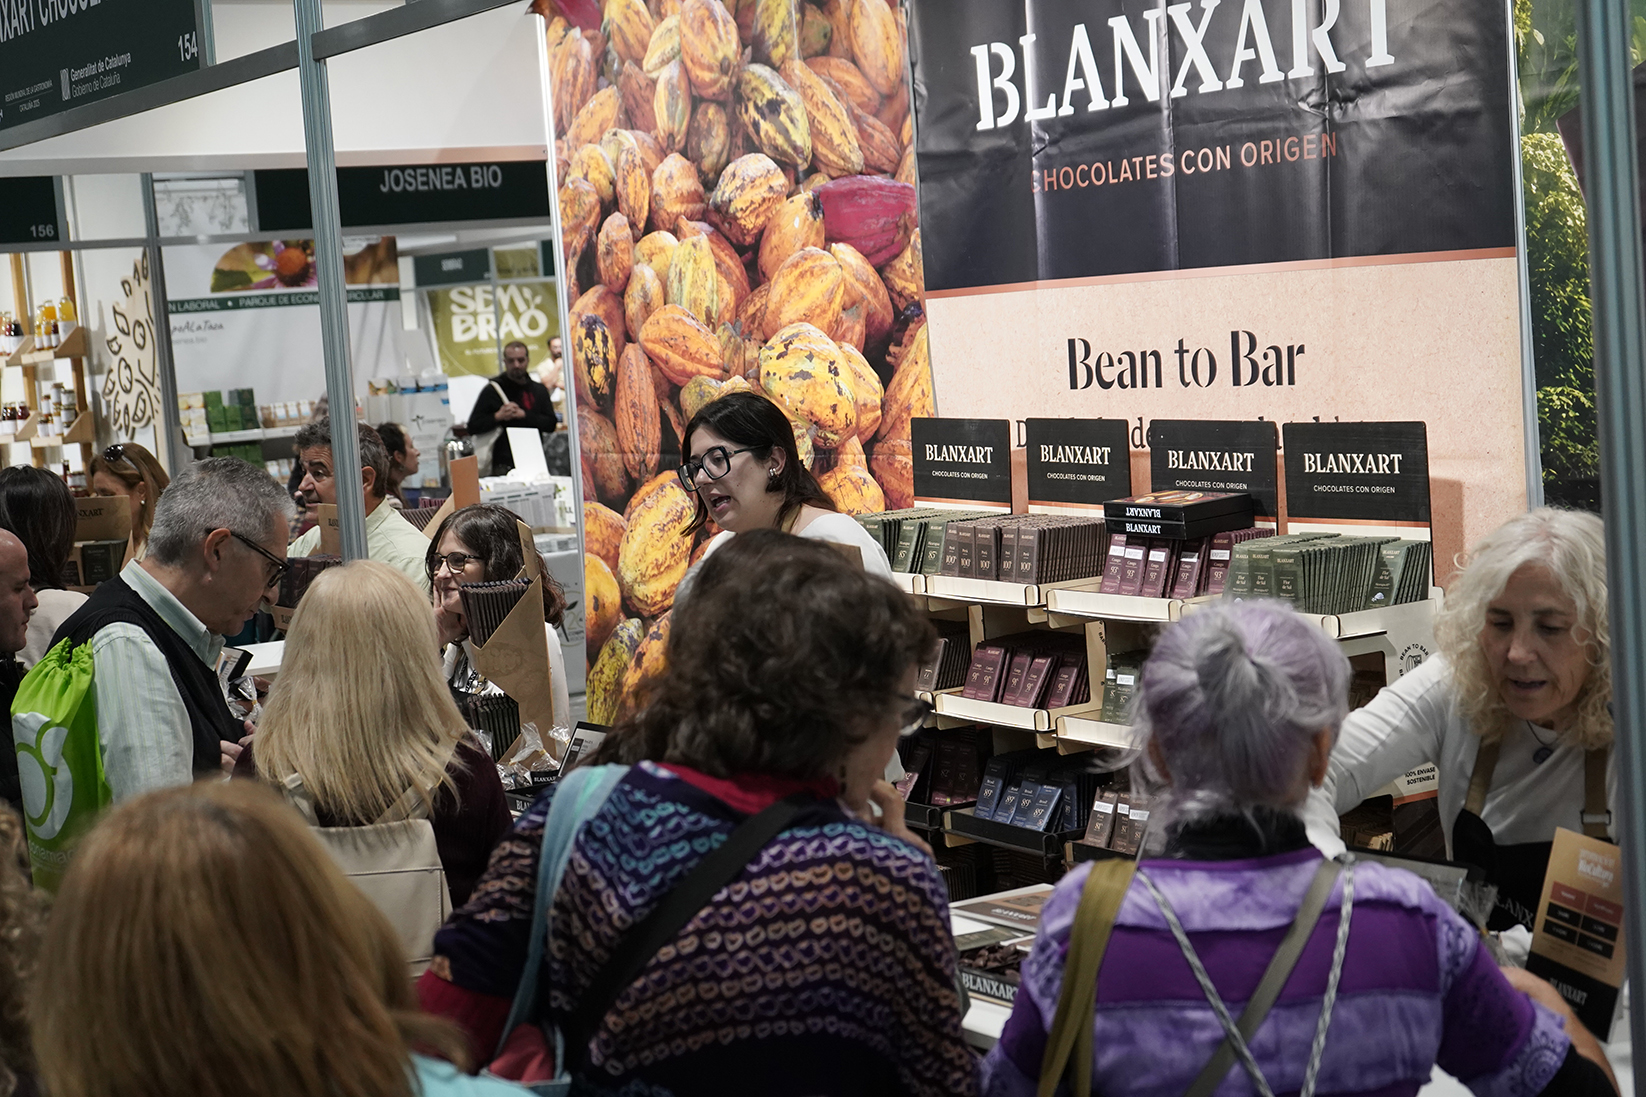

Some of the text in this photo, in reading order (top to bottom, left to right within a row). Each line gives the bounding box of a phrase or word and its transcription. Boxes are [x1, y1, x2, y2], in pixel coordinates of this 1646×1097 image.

[178, 31, 199, 61] 154
[70, 52, 132, 82] Generalitat de Catalunya
[970, 0, 1395, 131] BLANXART
[71, 83, 93, 98] Gobierno
[1030, 131, 1338, 194] CHOCOLATES CON ORIGEN
[380, 165, 502, 193] JOSENEA BIO
[30, 224, 54, 238] 156
[176, 299, 220, 312] LABORAL
[239, 295, 278, 307] PARQUE
[278, 294, 290, 305] DE
[1067, 329, 1305, 390] Bean to Bar
[925, 444, 993, 464] BLANXART
[1040, 445, 1111, 465] BLANXART
[1167, 450, 1254, 472] BLANXART
[1303, 453, 1402, 474] BLANXART
[932, 470, 988, 480] CHOCOLATES CON ORIGEN
[1046, 472, 1105, 482] CHOCOLATES CON ORIGEN
[1175, 479, 1247, 490] CHOCOLATES CON ORIGEN
[1313, 484, 1395, 494] CHOCOLATES CON ORIGEN
[1125, 507, 1161, 518] BLANXART
[1125, 523, 1161, 534] BLANXART
